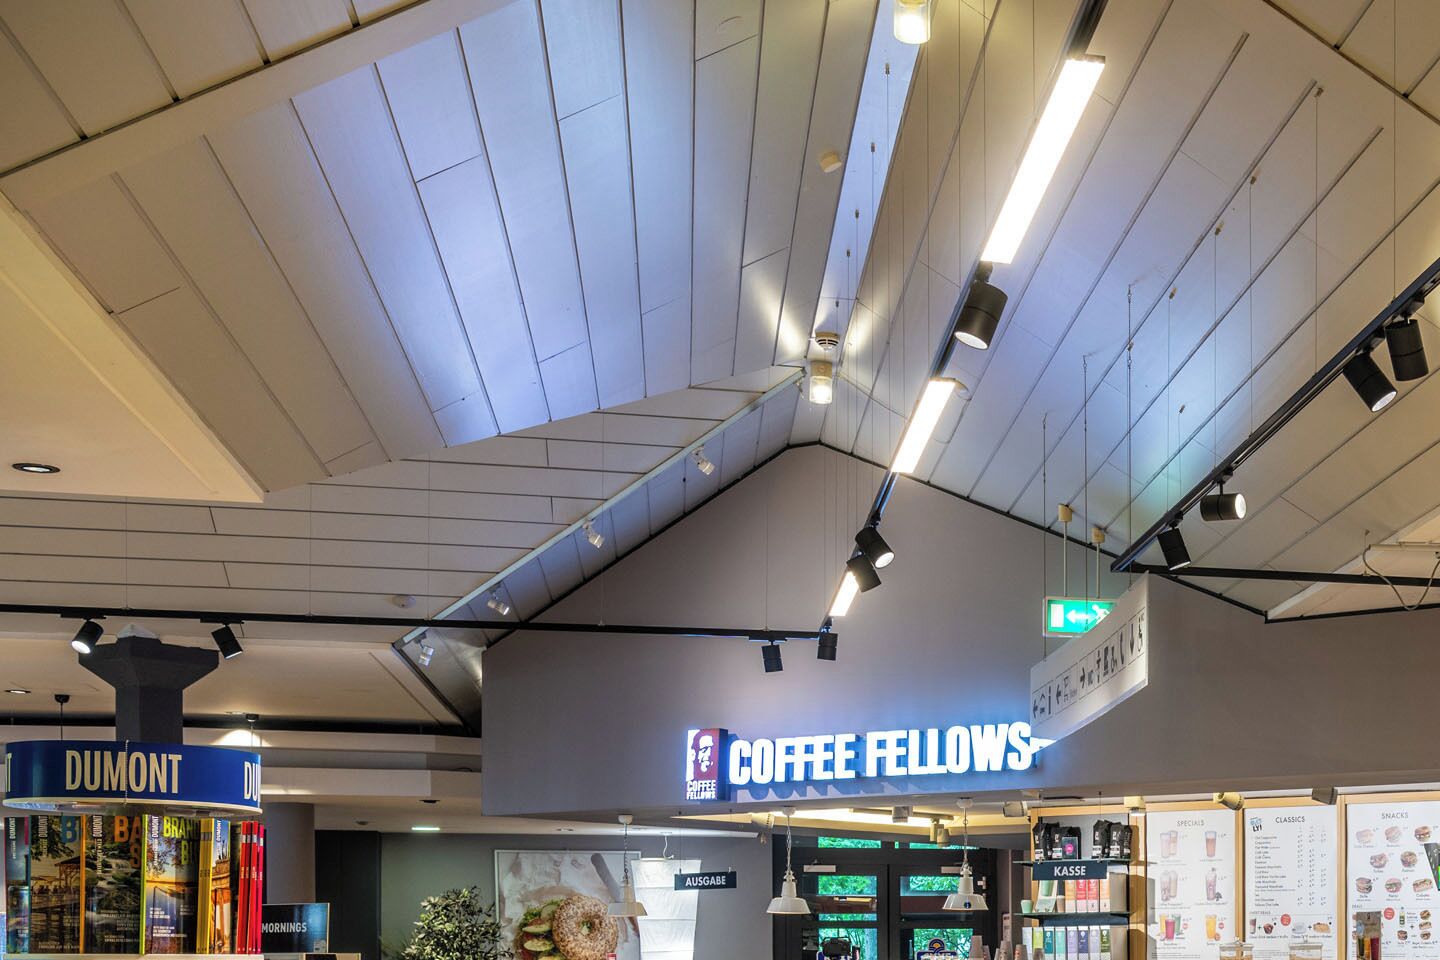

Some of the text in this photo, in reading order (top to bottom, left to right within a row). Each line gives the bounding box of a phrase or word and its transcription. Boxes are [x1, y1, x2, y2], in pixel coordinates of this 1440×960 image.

[729, 721, 1031, 785] COFFEE FELLOWS
[65, 750, 182, 794] DUMONT
[687, 780, 717, 792] COFFEE
[686, 791, 717, 800] FELLOWS
[39, 815, 48, 837] DUMONT
[93, 815, 102, 837] DUMONT
[1275, 816, 1305, 824] CLASSICS
[150, 816, 159, 838] DUMONT
[1054, 866, 1086, 876] KASSE
[685, 876, 726, 886] AUSGABE
[261, 922, 307, 934] MORNINGS
